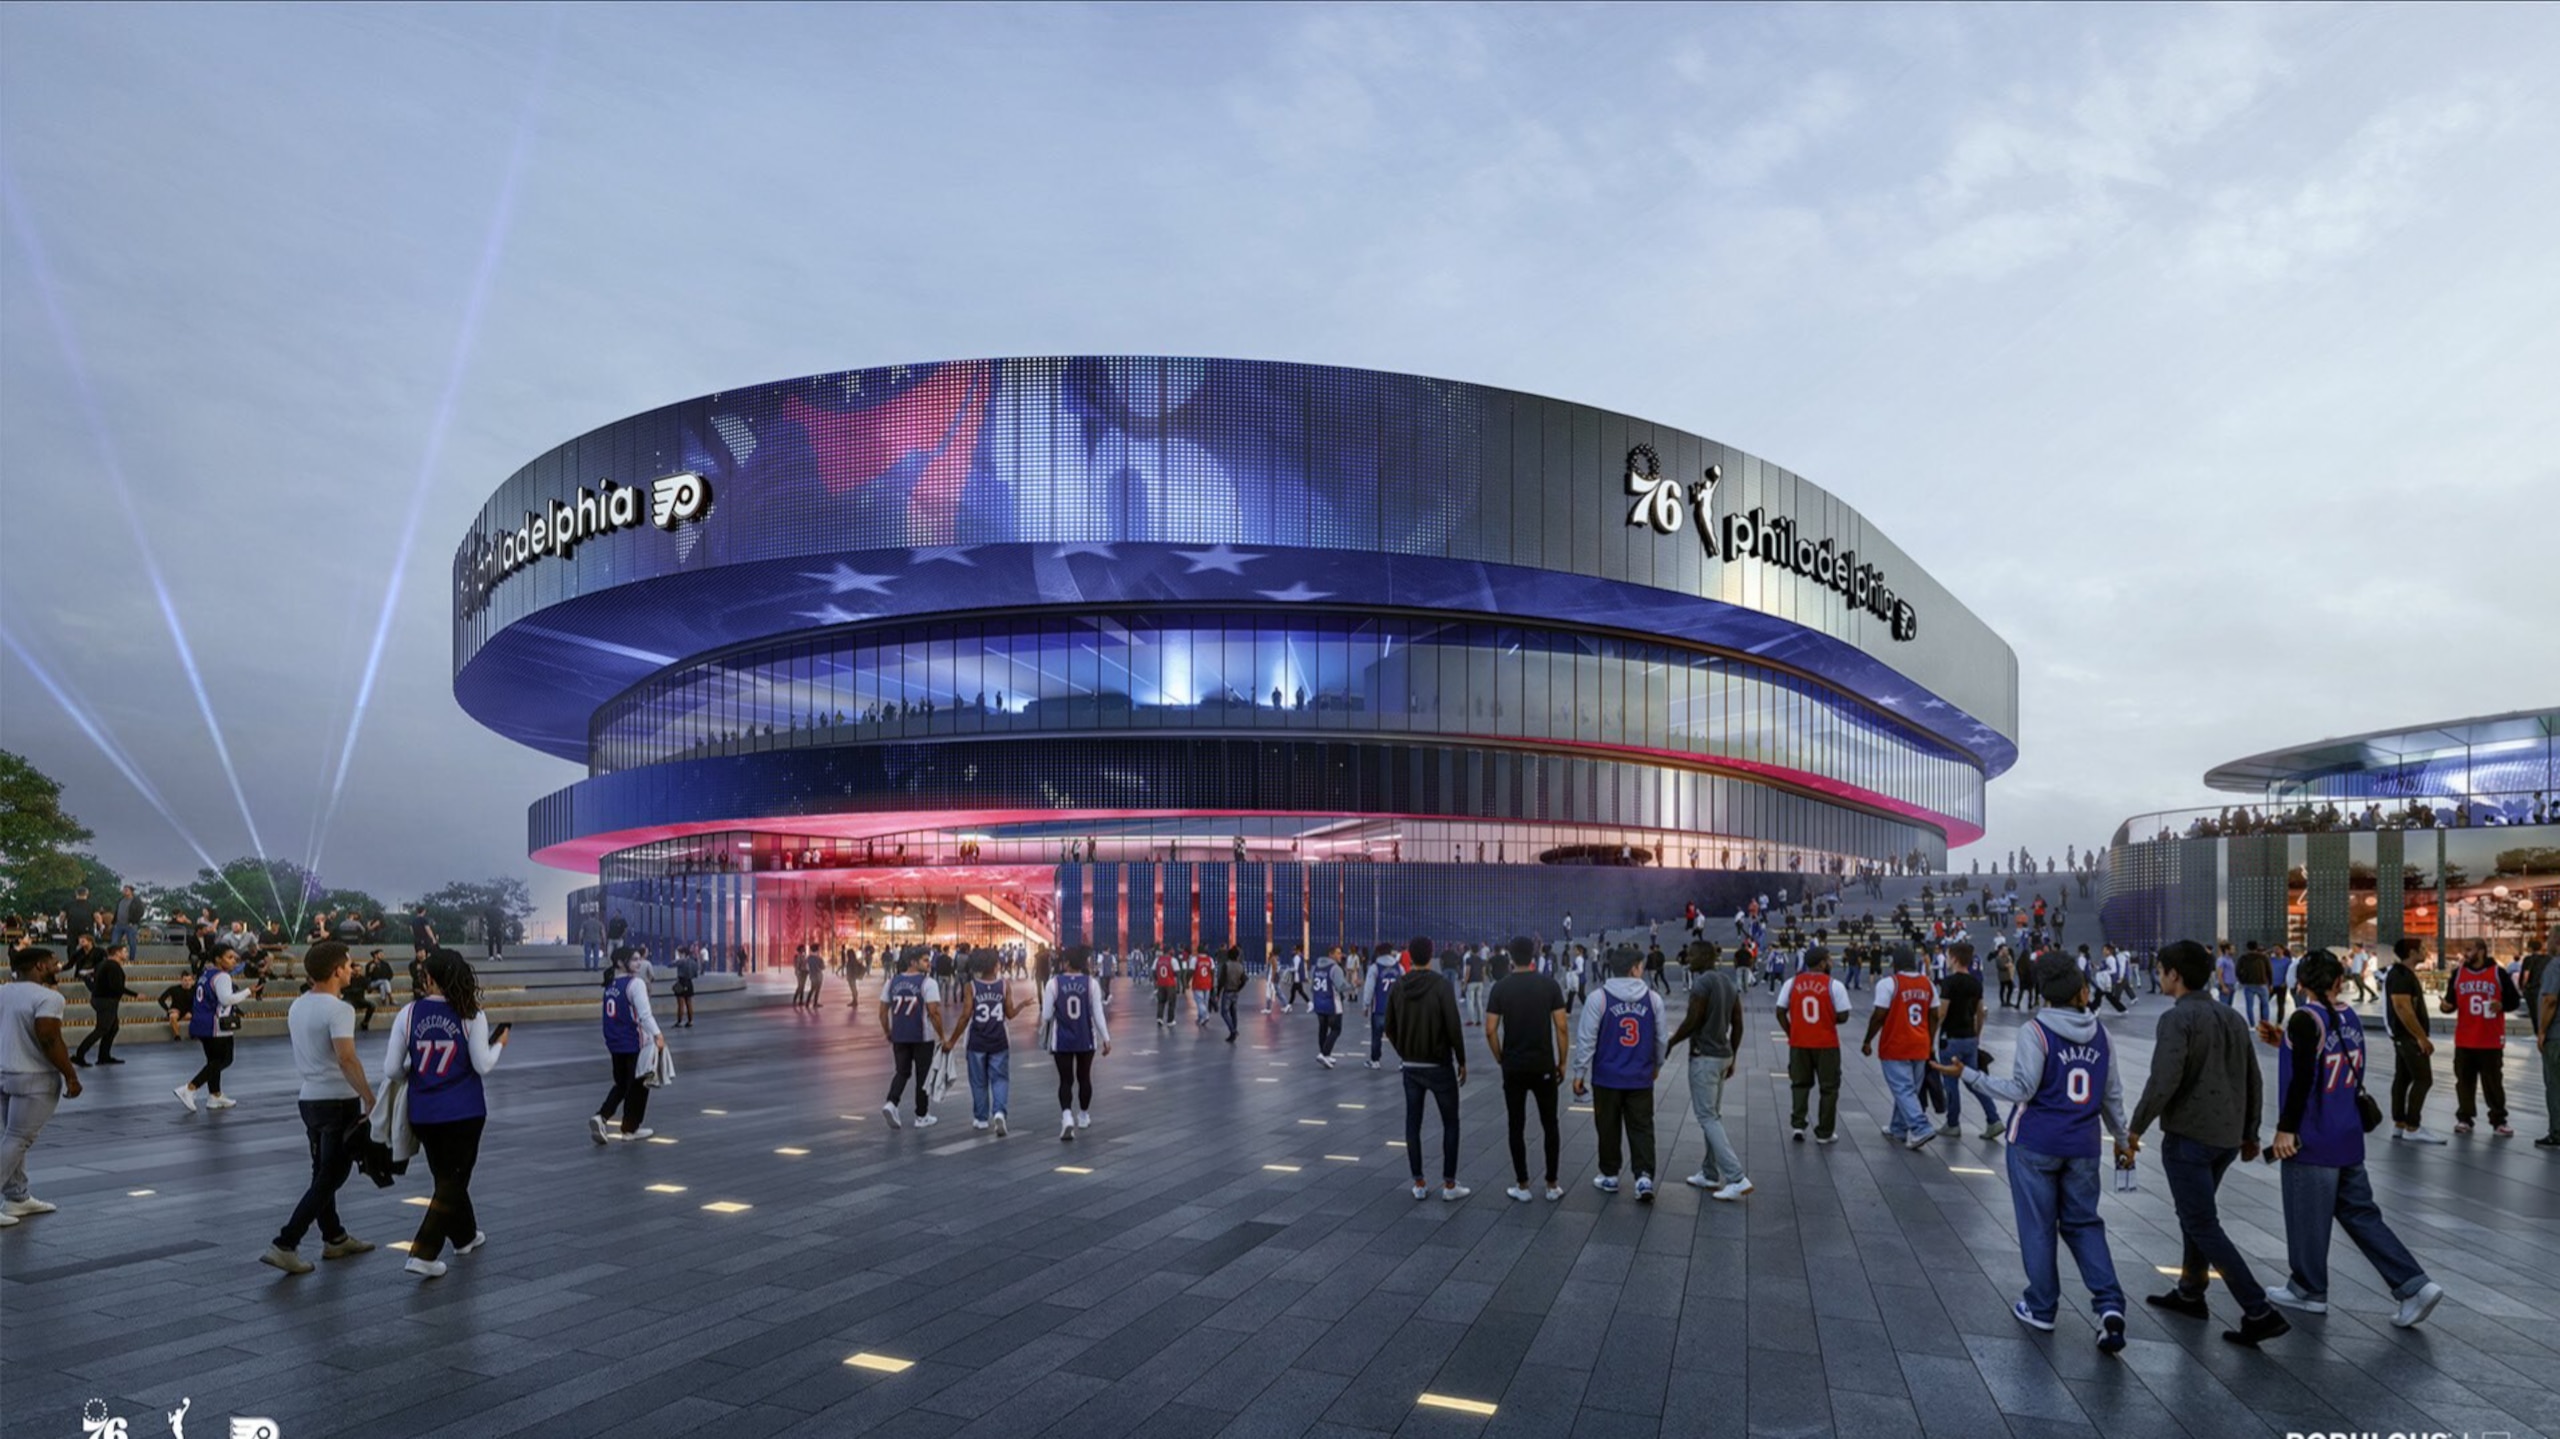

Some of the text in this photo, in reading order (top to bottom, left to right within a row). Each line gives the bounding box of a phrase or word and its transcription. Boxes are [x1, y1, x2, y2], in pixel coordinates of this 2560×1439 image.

[1630, 472, 1683, 533] 76
[1731, 507, 1894, 622] philadelphia
[196, 985, 203, 1002] 0
[1313, 977, 1328, 992] 34
[1795, 980, 1827, 994] MAXEY
[2459, 980, 2496, 996] SIXERS
[606, 998, 616, 1018] 0
[892, 995, 918, 1017] 77
[975, 1003, 1004, 1023] 34
[1067, 995, 1081, 1020] 0
[1609, 1001, 1649, 1017] IVERSON
[1801, 995, 1820, 1024] 0
[1908, 1003, 1922, 1026] 6
[414, 1015, 461, 1038] EDGECOMBE
[1619, 1017, 1639, 1047] 3
[2324, 1025, 2364, 1052] EDGCOMBE
[416, 1040, 458, 1076] 77
[2057, 1046, 2101, 1065] MAXEY
[2067, 1067, 2092, 1104] 0
